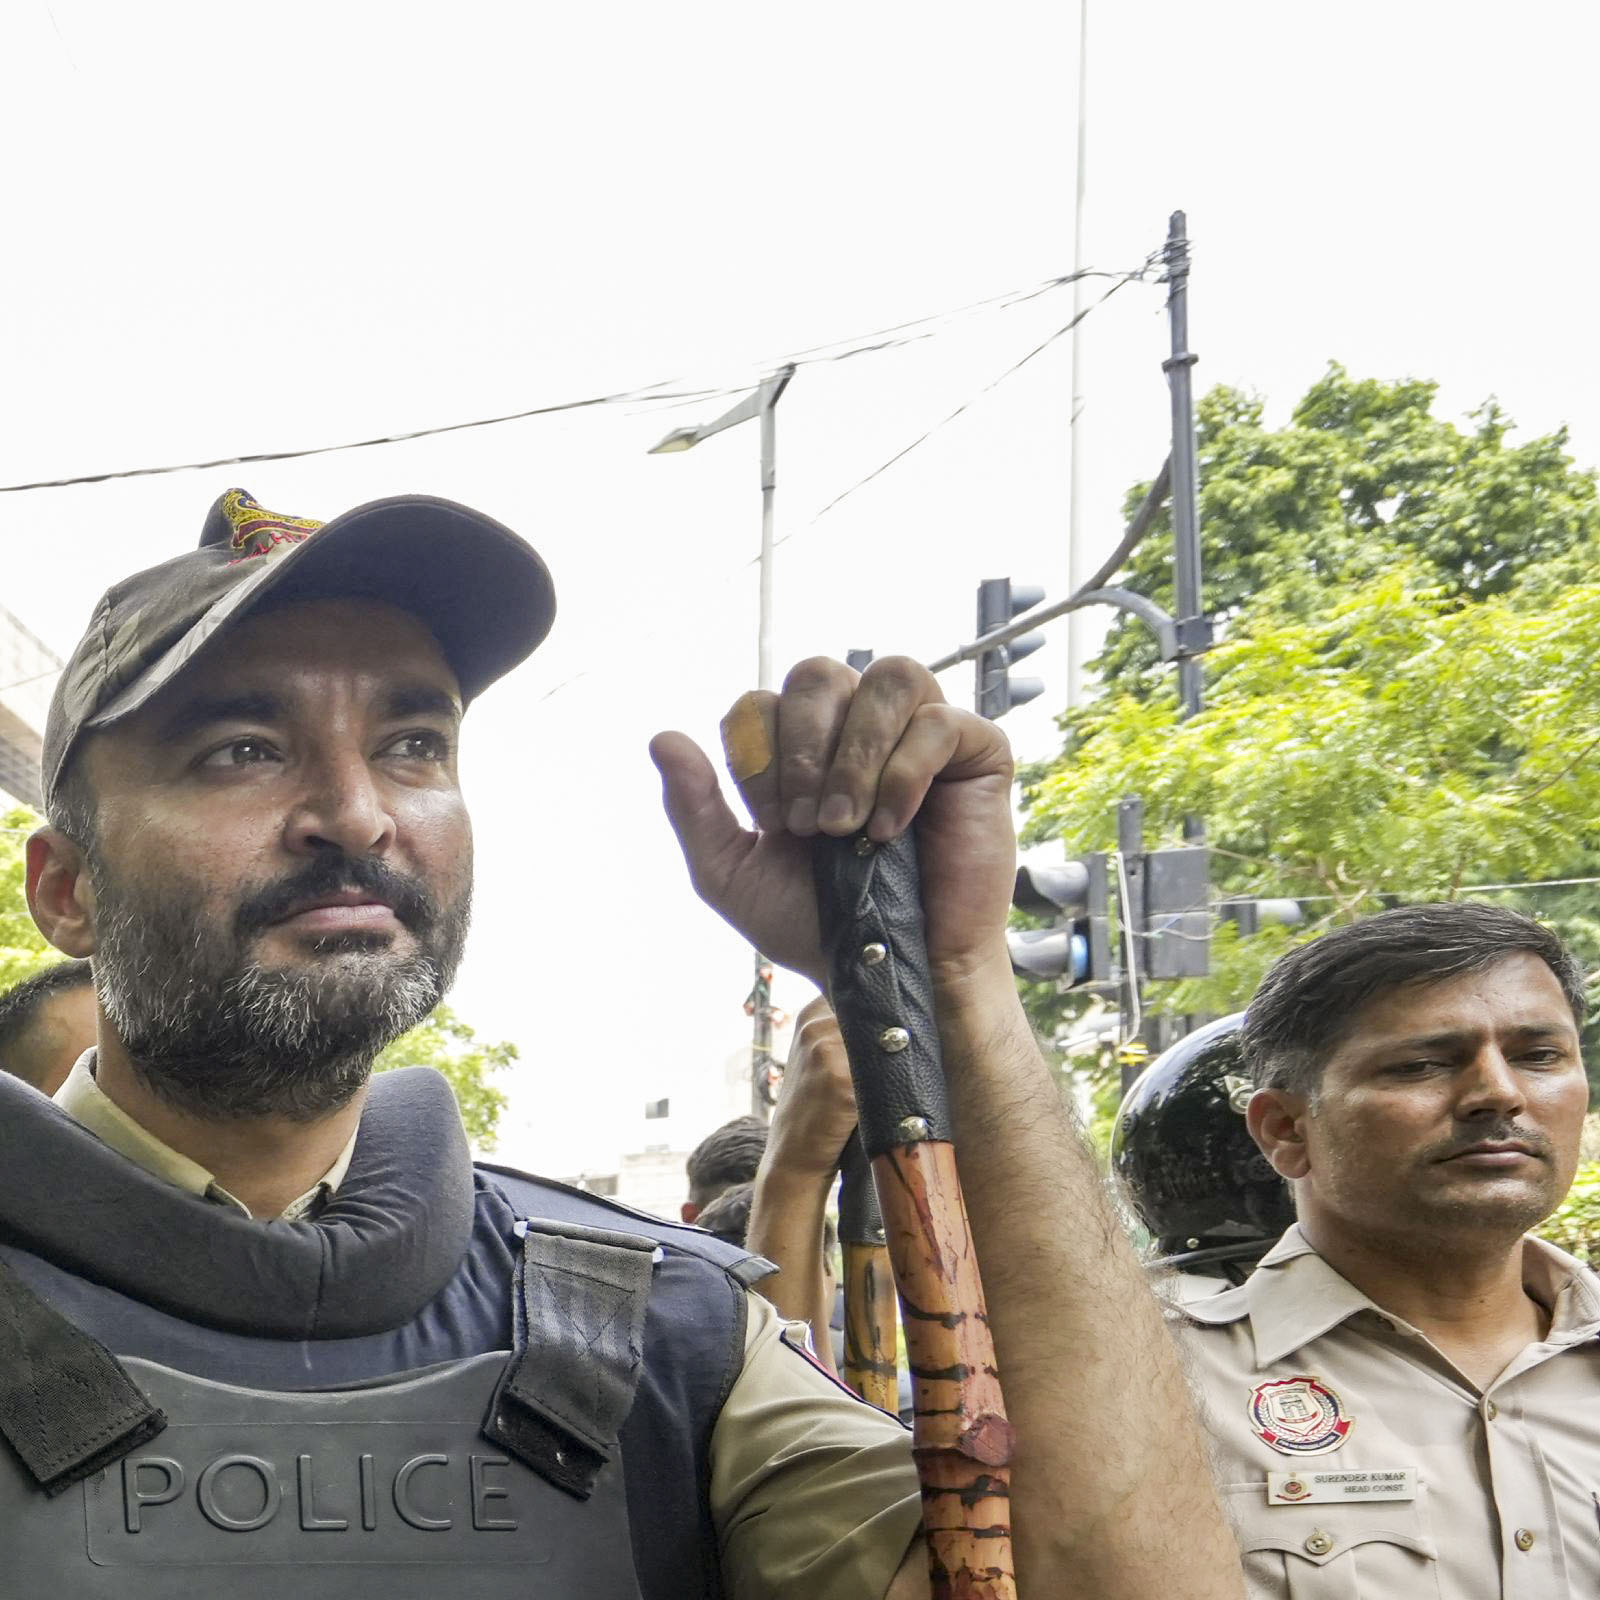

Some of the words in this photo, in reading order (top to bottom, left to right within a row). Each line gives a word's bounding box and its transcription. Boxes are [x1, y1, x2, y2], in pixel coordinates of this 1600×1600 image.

[1315, 1473, 1368, 1483] SURENDER
[1371, 1472, 1406, 1482] KUMAR
[121, 1452, 521, 1534] POLICE
[1344, 1485, 1370, 1493] HEAD
